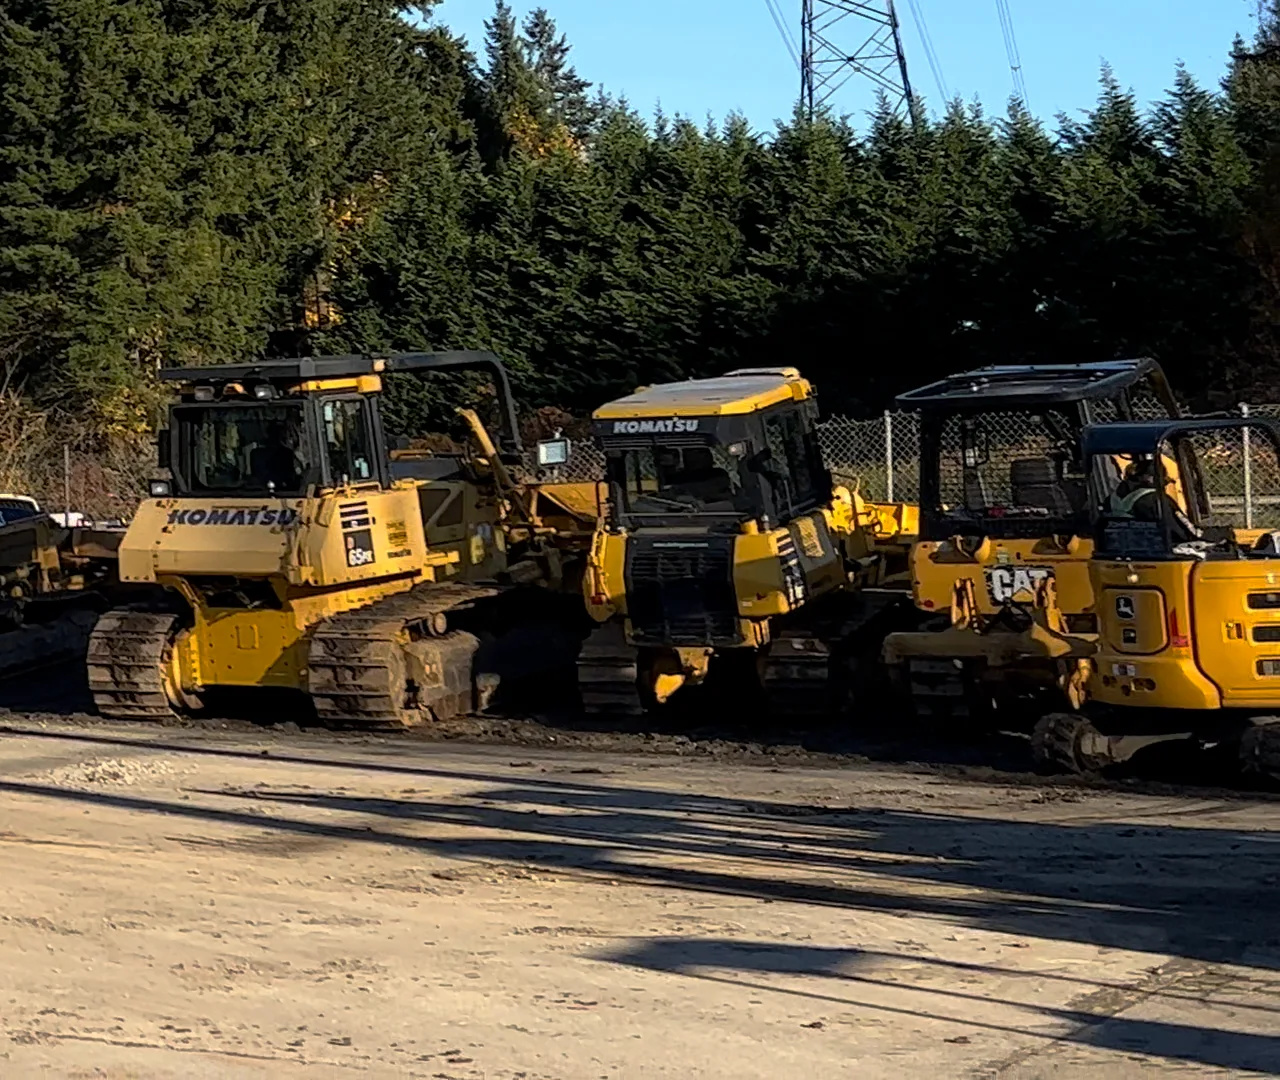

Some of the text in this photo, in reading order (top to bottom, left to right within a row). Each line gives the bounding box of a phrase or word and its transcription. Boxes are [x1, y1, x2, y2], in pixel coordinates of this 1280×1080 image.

[613, 420, 699, 434] KOMATSU
[167, 508, 298, 526] KOMATSU
[991, 568, 1048, 604] CAT
